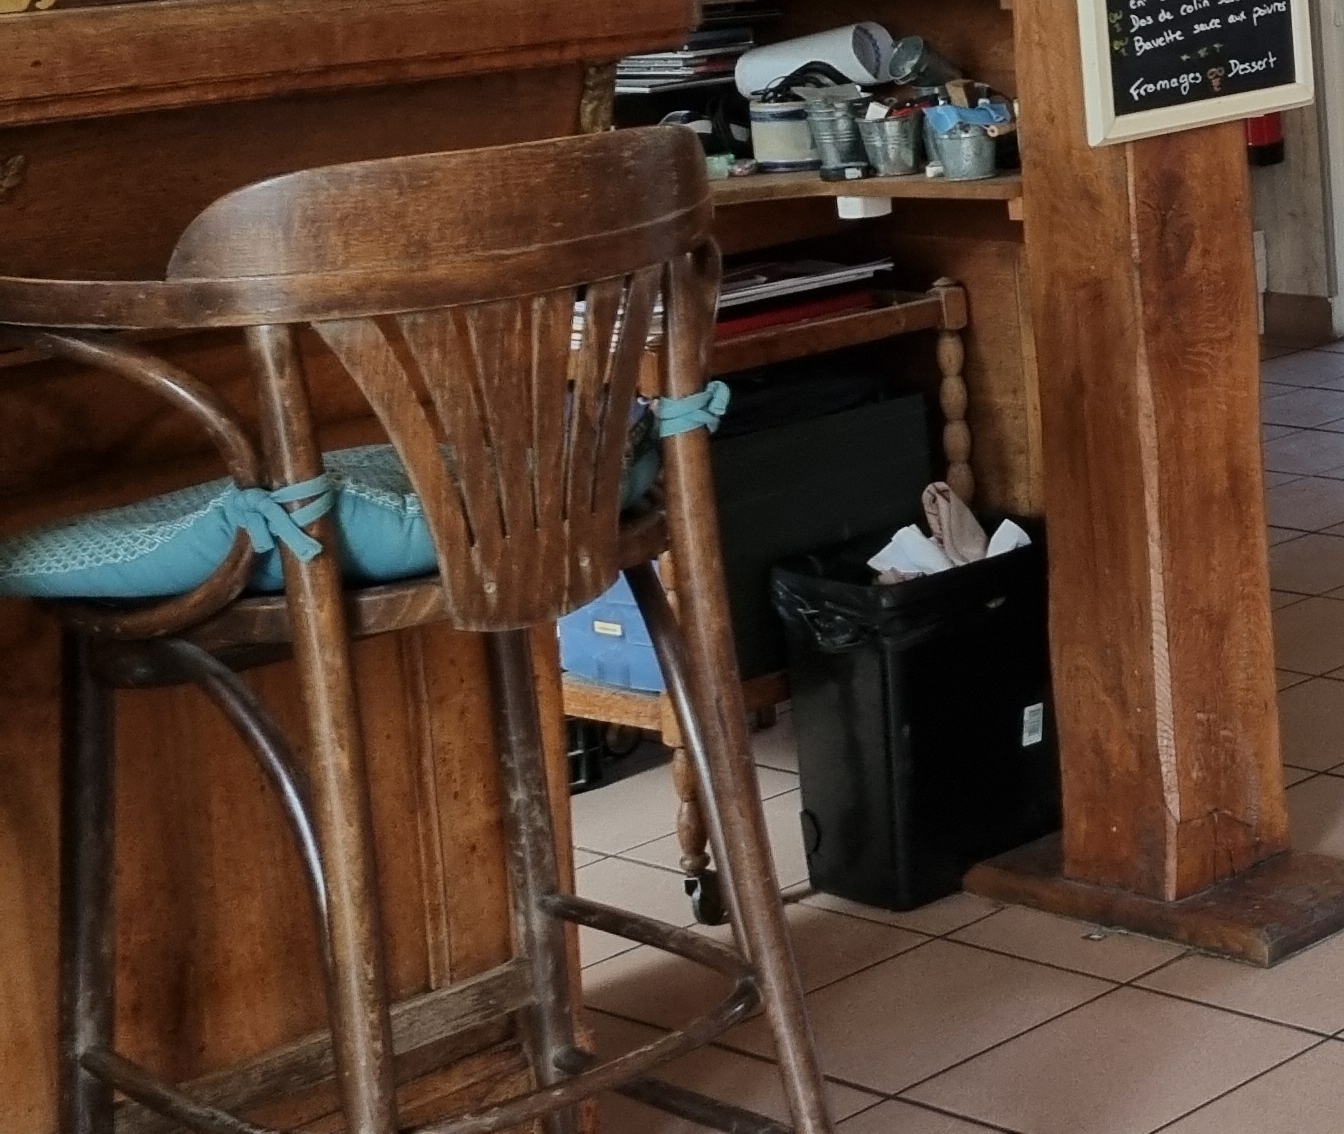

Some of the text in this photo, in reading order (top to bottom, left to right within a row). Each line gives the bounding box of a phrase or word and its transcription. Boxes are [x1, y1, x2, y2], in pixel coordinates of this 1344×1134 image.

[1129, 14, 1155, 34] Dos
[1158, 8, 1175, 23] de
[1133, 29, 1185, 57] Bavette
[1192, 18, 1222, 34] sauce
[1227, 11, 1247, 25] aux
[1252, 0, 1288, 27] poivres
[1129, 70, 1203, 101] Fromages
[1227, 50, 1279, 78] Dessert
